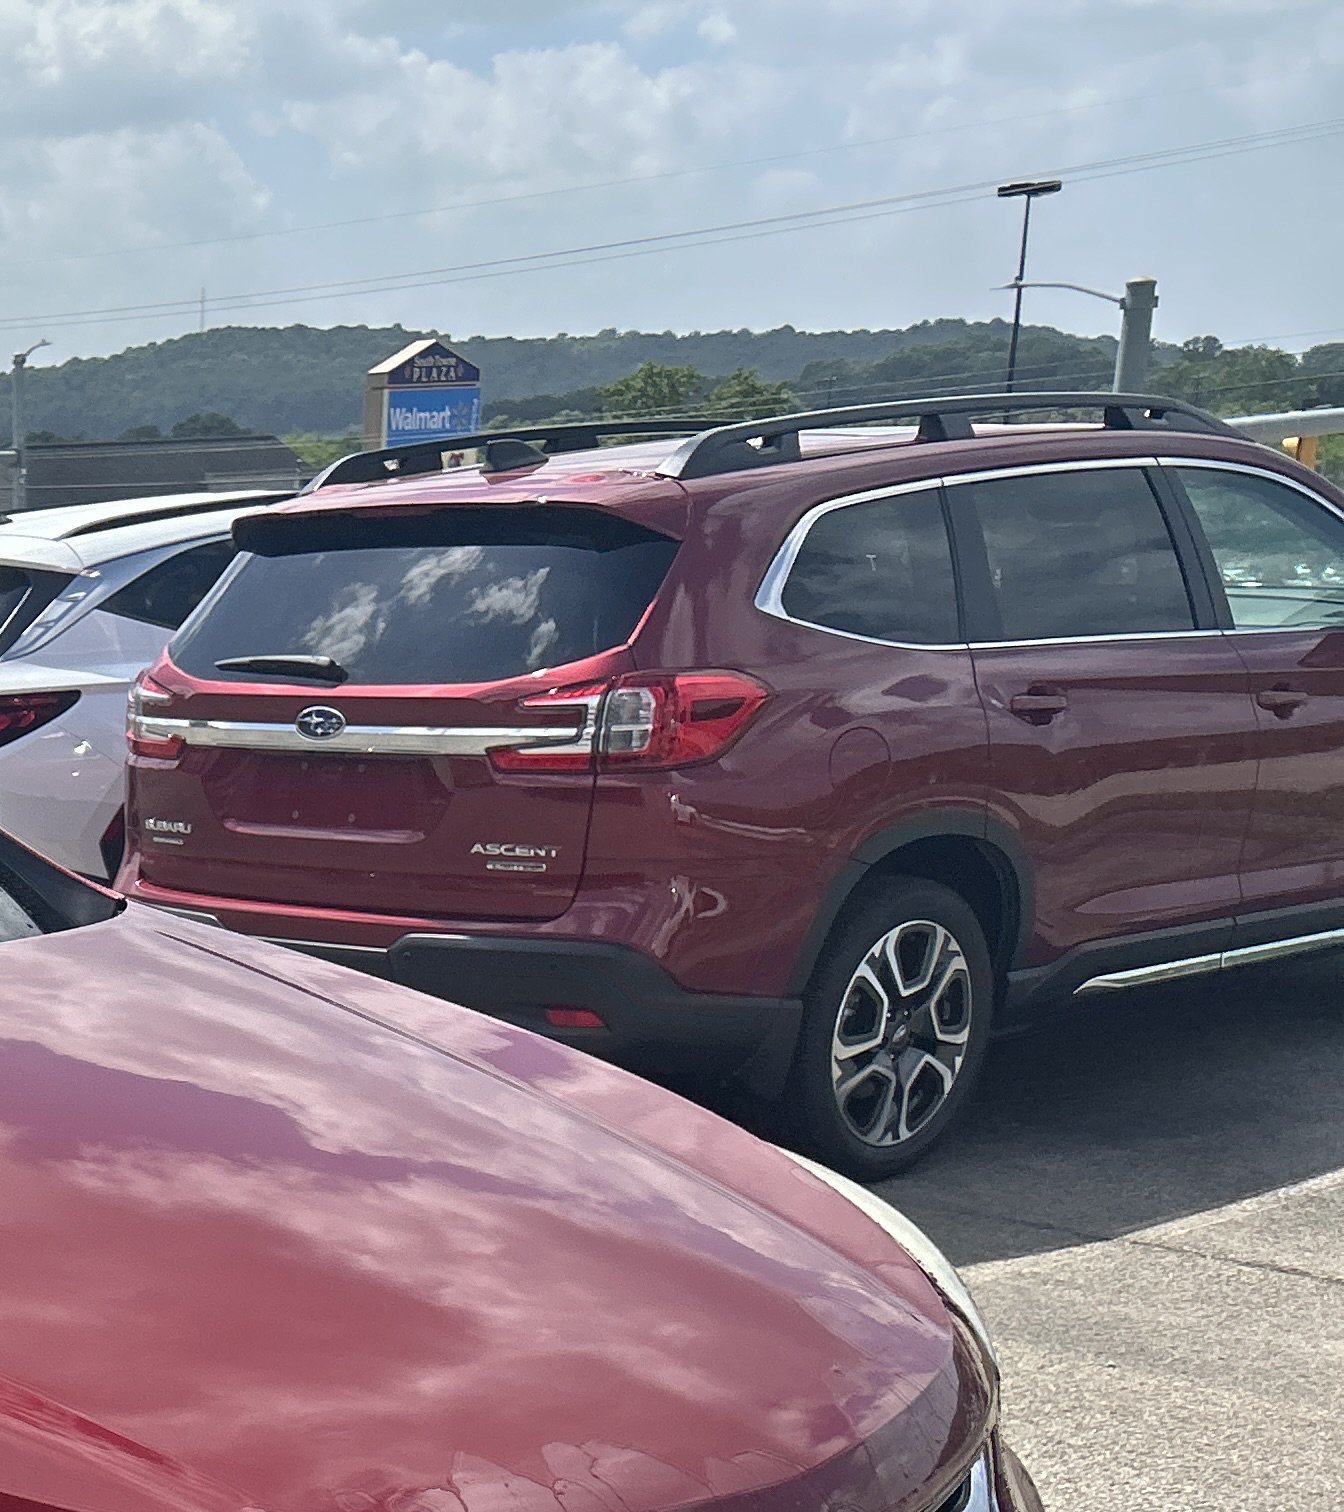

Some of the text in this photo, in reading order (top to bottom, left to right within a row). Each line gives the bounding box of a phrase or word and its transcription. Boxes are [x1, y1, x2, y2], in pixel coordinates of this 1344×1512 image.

[413, 367, 457, 382] PLAZA
[389, 405, 451, 431] Walmart
[471, 843, 562, 858] ASCENT
